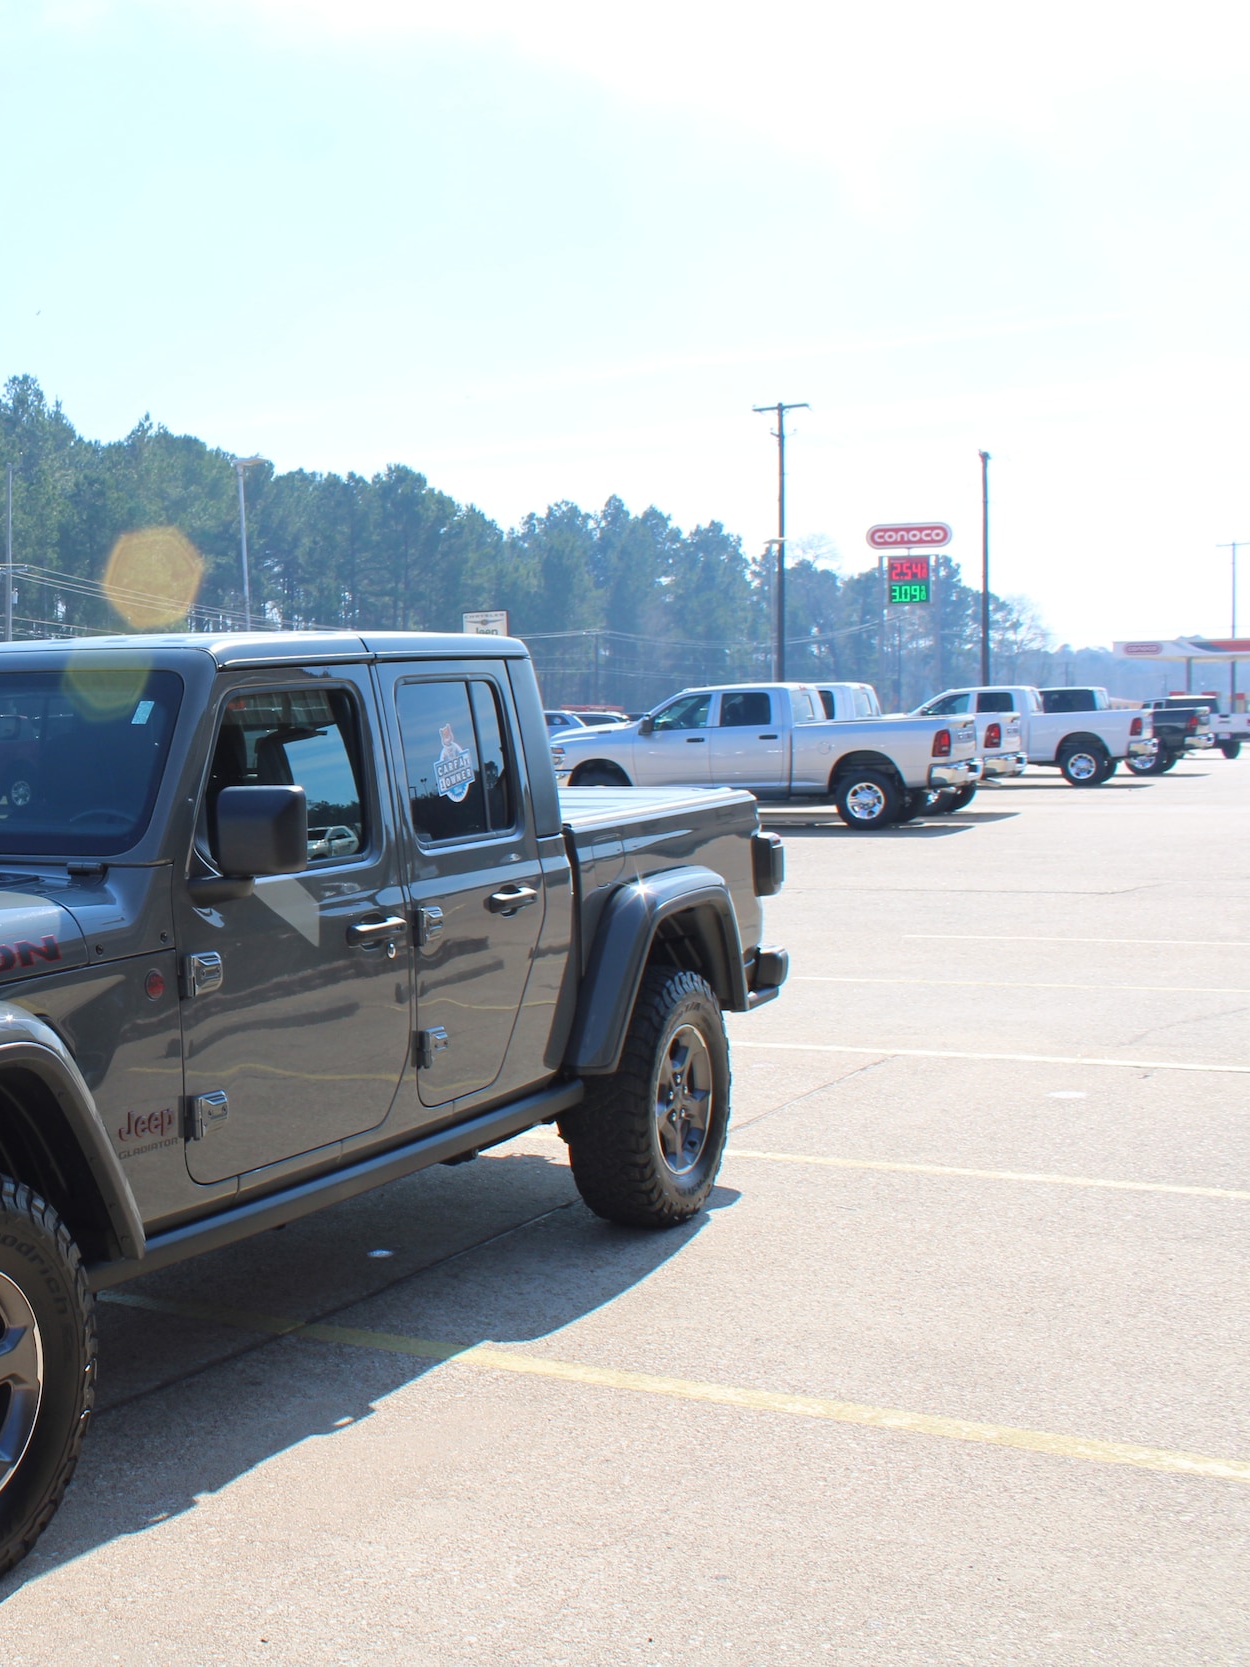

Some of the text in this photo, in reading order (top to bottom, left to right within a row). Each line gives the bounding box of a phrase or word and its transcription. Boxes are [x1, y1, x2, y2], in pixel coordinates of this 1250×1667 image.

[437, 757, 470, 776] CARFAX
[118, 1107, 174, 1142] Jeep
[118, 1137, 179, 1161] GLADIATOR
